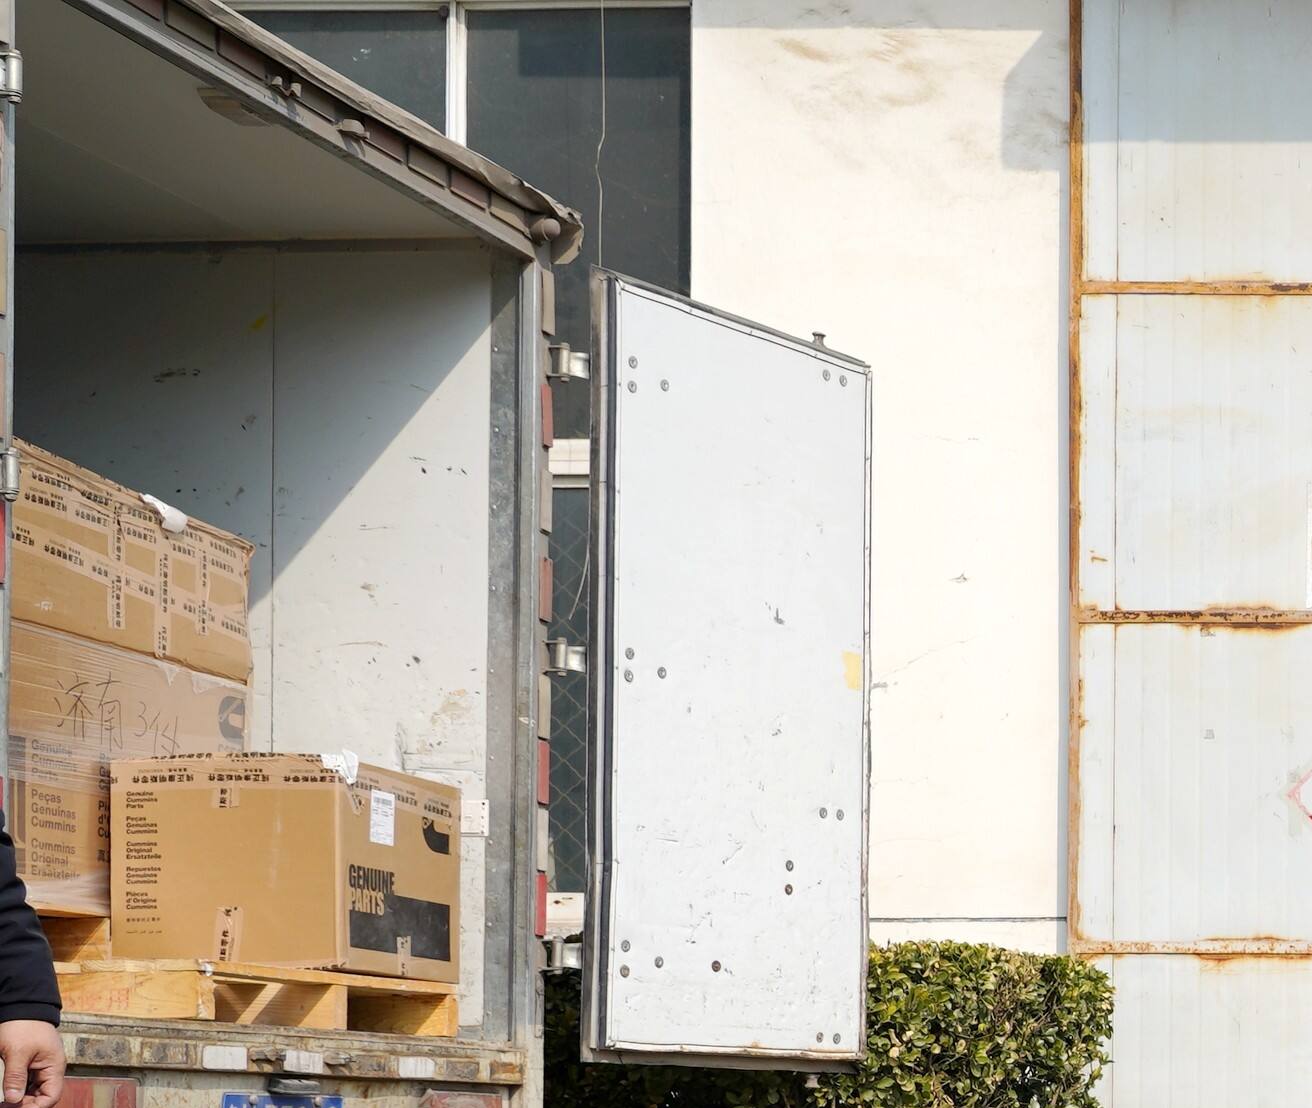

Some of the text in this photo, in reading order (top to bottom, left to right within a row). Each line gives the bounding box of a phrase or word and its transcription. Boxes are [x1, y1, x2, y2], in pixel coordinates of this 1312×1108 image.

[31, 788, 62, 805] Peças
[31, 815, 77, 833] Cummins
[31, 838, 76, 855] Cummins
[31, 851, 69, 867] Original
[349, 863, 395, 896] GENUINE
[350, 887, 385, 916] PARTS
